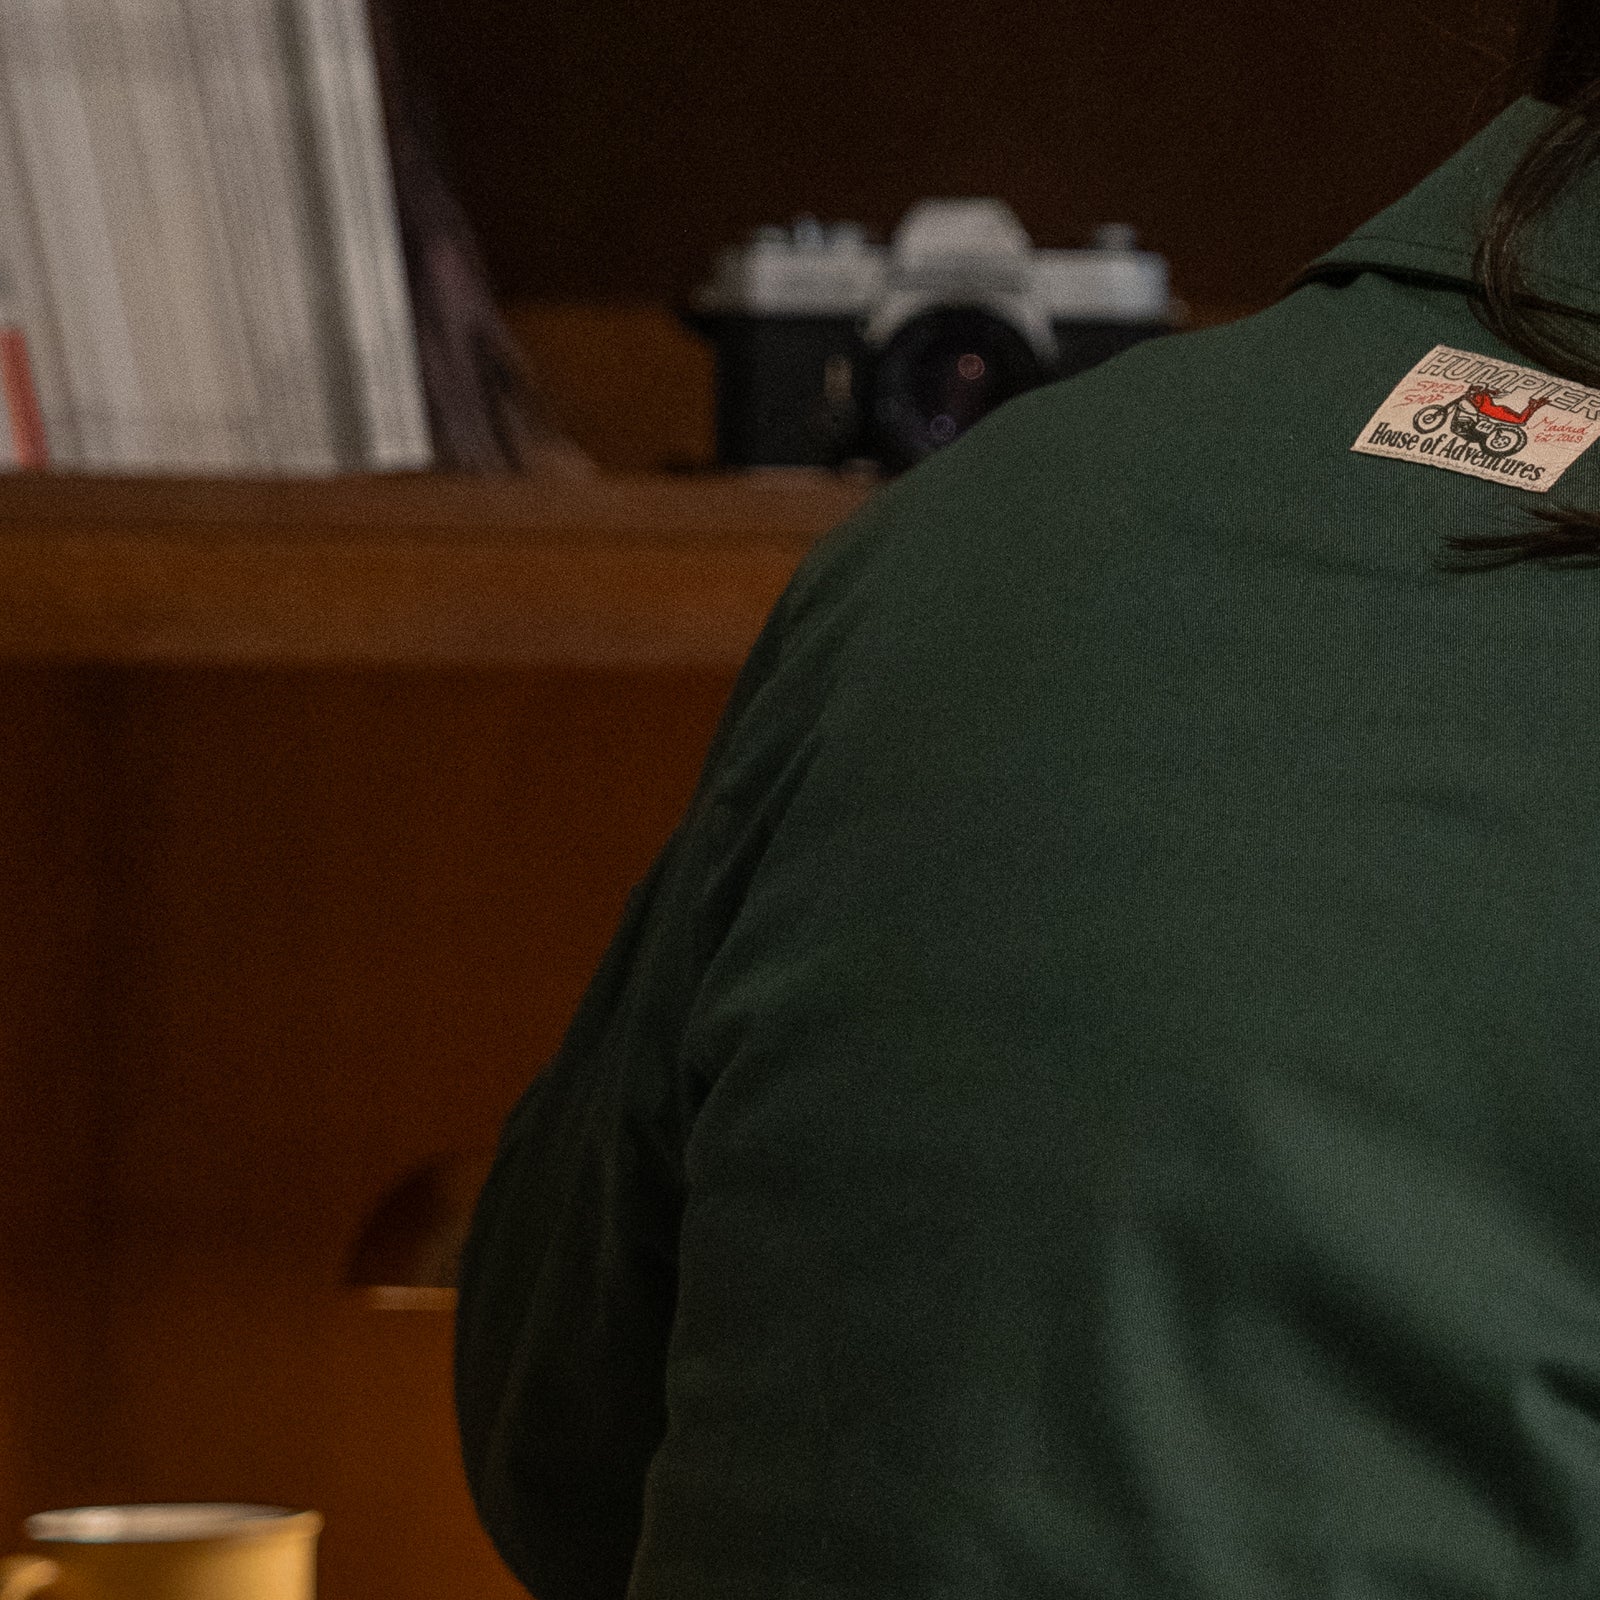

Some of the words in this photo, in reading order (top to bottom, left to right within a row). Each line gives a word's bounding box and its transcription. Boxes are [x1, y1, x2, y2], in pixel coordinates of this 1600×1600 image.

[1367, 421, 1420, 450] House
[1420, 433, 1448, 455] of
[1442, 436, 1547, 482] Adventures
